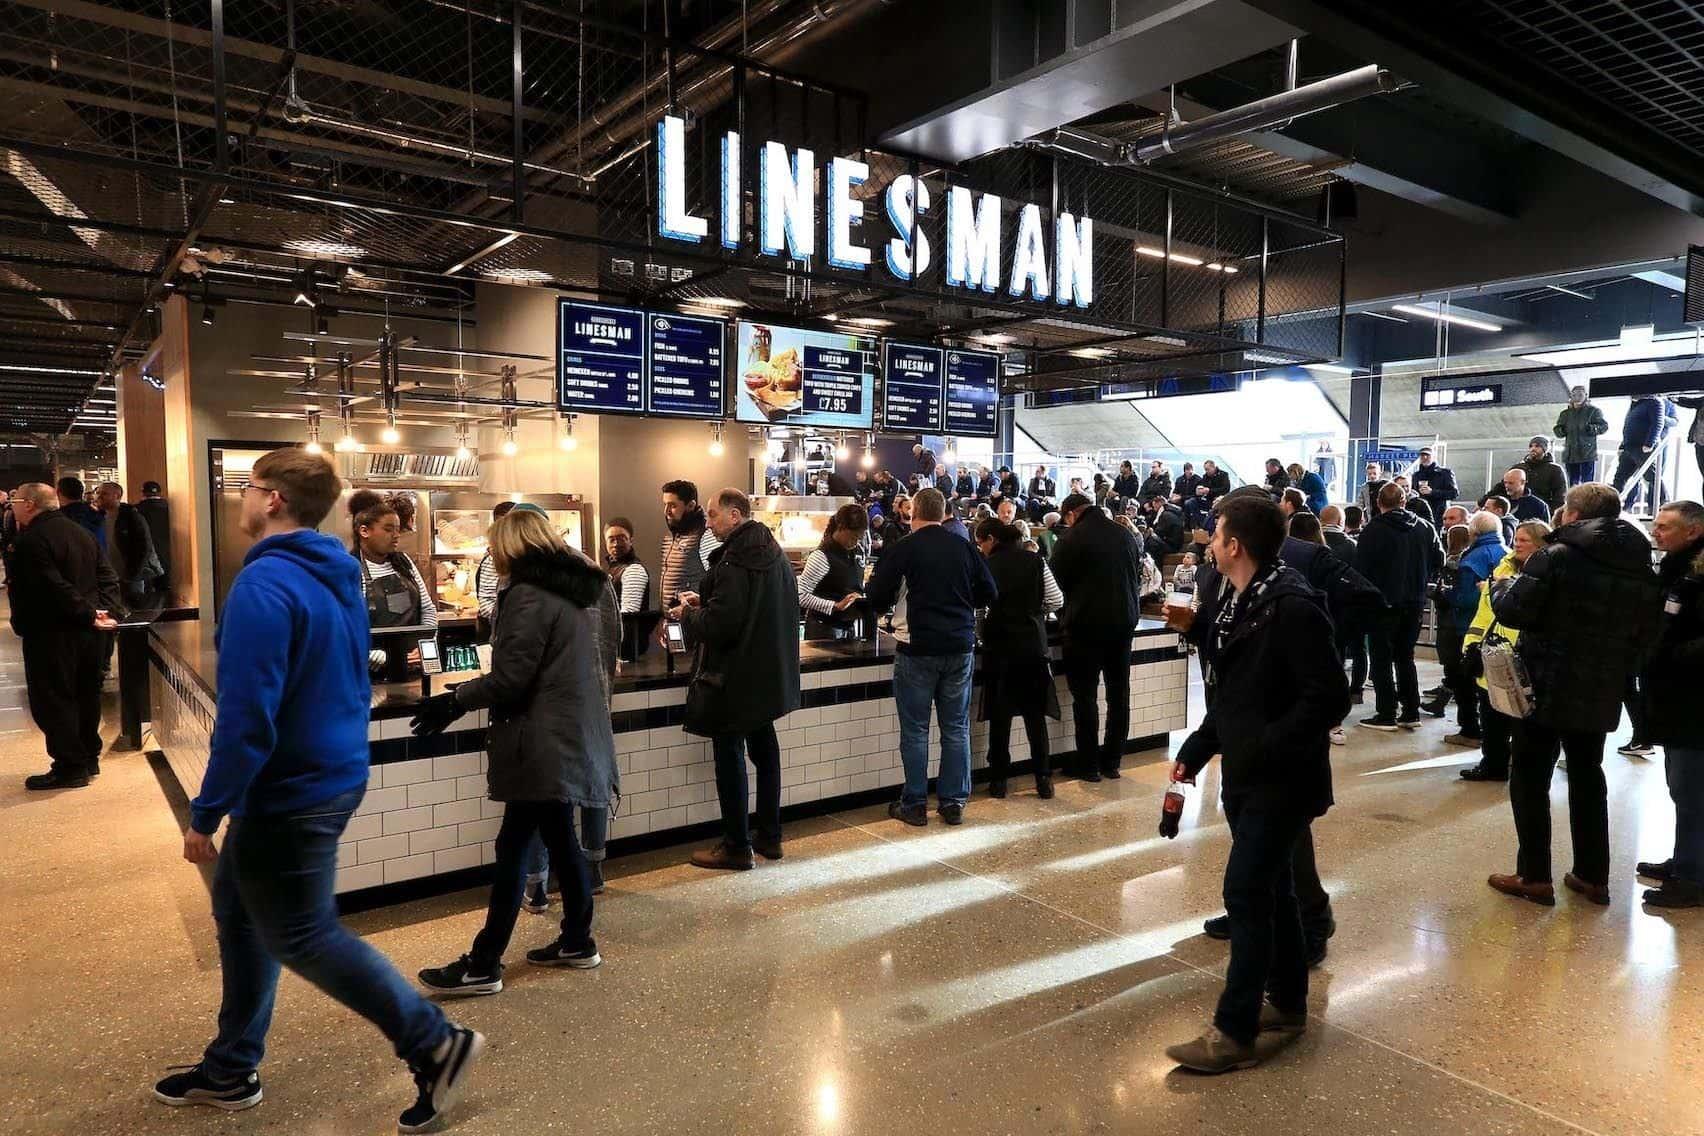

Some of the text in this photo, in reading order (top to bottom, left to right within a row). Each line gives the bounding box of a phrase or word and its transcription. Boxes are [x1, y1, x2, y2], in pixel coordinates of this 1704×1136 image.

[658, 115, 1093, 308] LINESMAN
[575, 322, 631, 340] LINESMAN
[819, 354, 849, 365] LINESMAN
[895, 358, 934, 373] LINESMAN
[819, 397, 847, 411] £7.95
